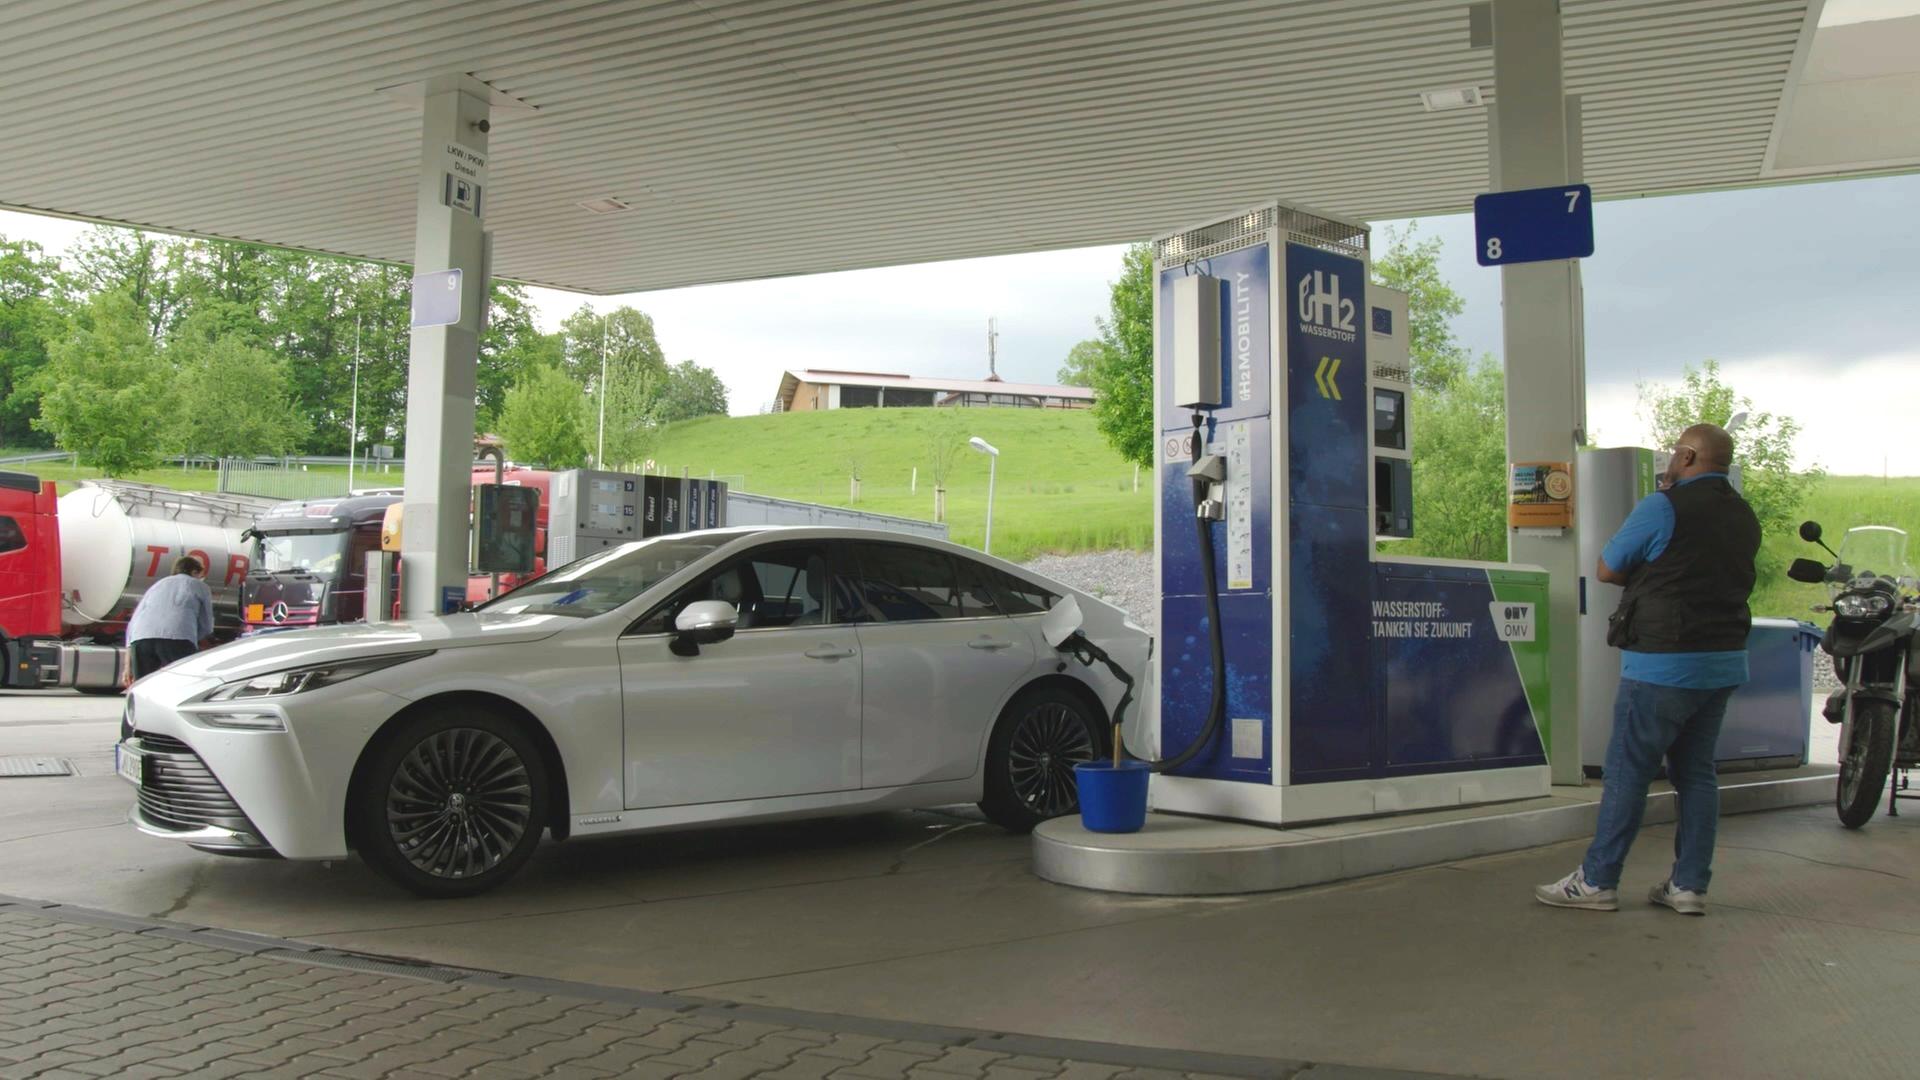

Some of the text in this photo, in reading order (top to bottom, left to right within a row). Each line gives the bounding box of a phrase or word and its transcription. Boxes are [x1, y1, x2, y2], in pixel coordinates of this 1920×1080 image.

[455, 161, 477, 177] Diesel
[1564, 191, 1580, 213] 7
[1487, 237, 1502, 259] 8
[447, 274, 457, 290] 9
[1300, 322, 1357, 343] WASSERSTOFF
[624, 506, 633, 515] 15
[647, 496, 656, 521] Diesel
[666, 497, 674, 522] Diesel
[1372, 601, 1445, 618] WASSERSTOFF:
[1372, 621, 1473, 638] TANKEN SIE ZUKUNFT
[1504, 624, 1528, 637] OMV
